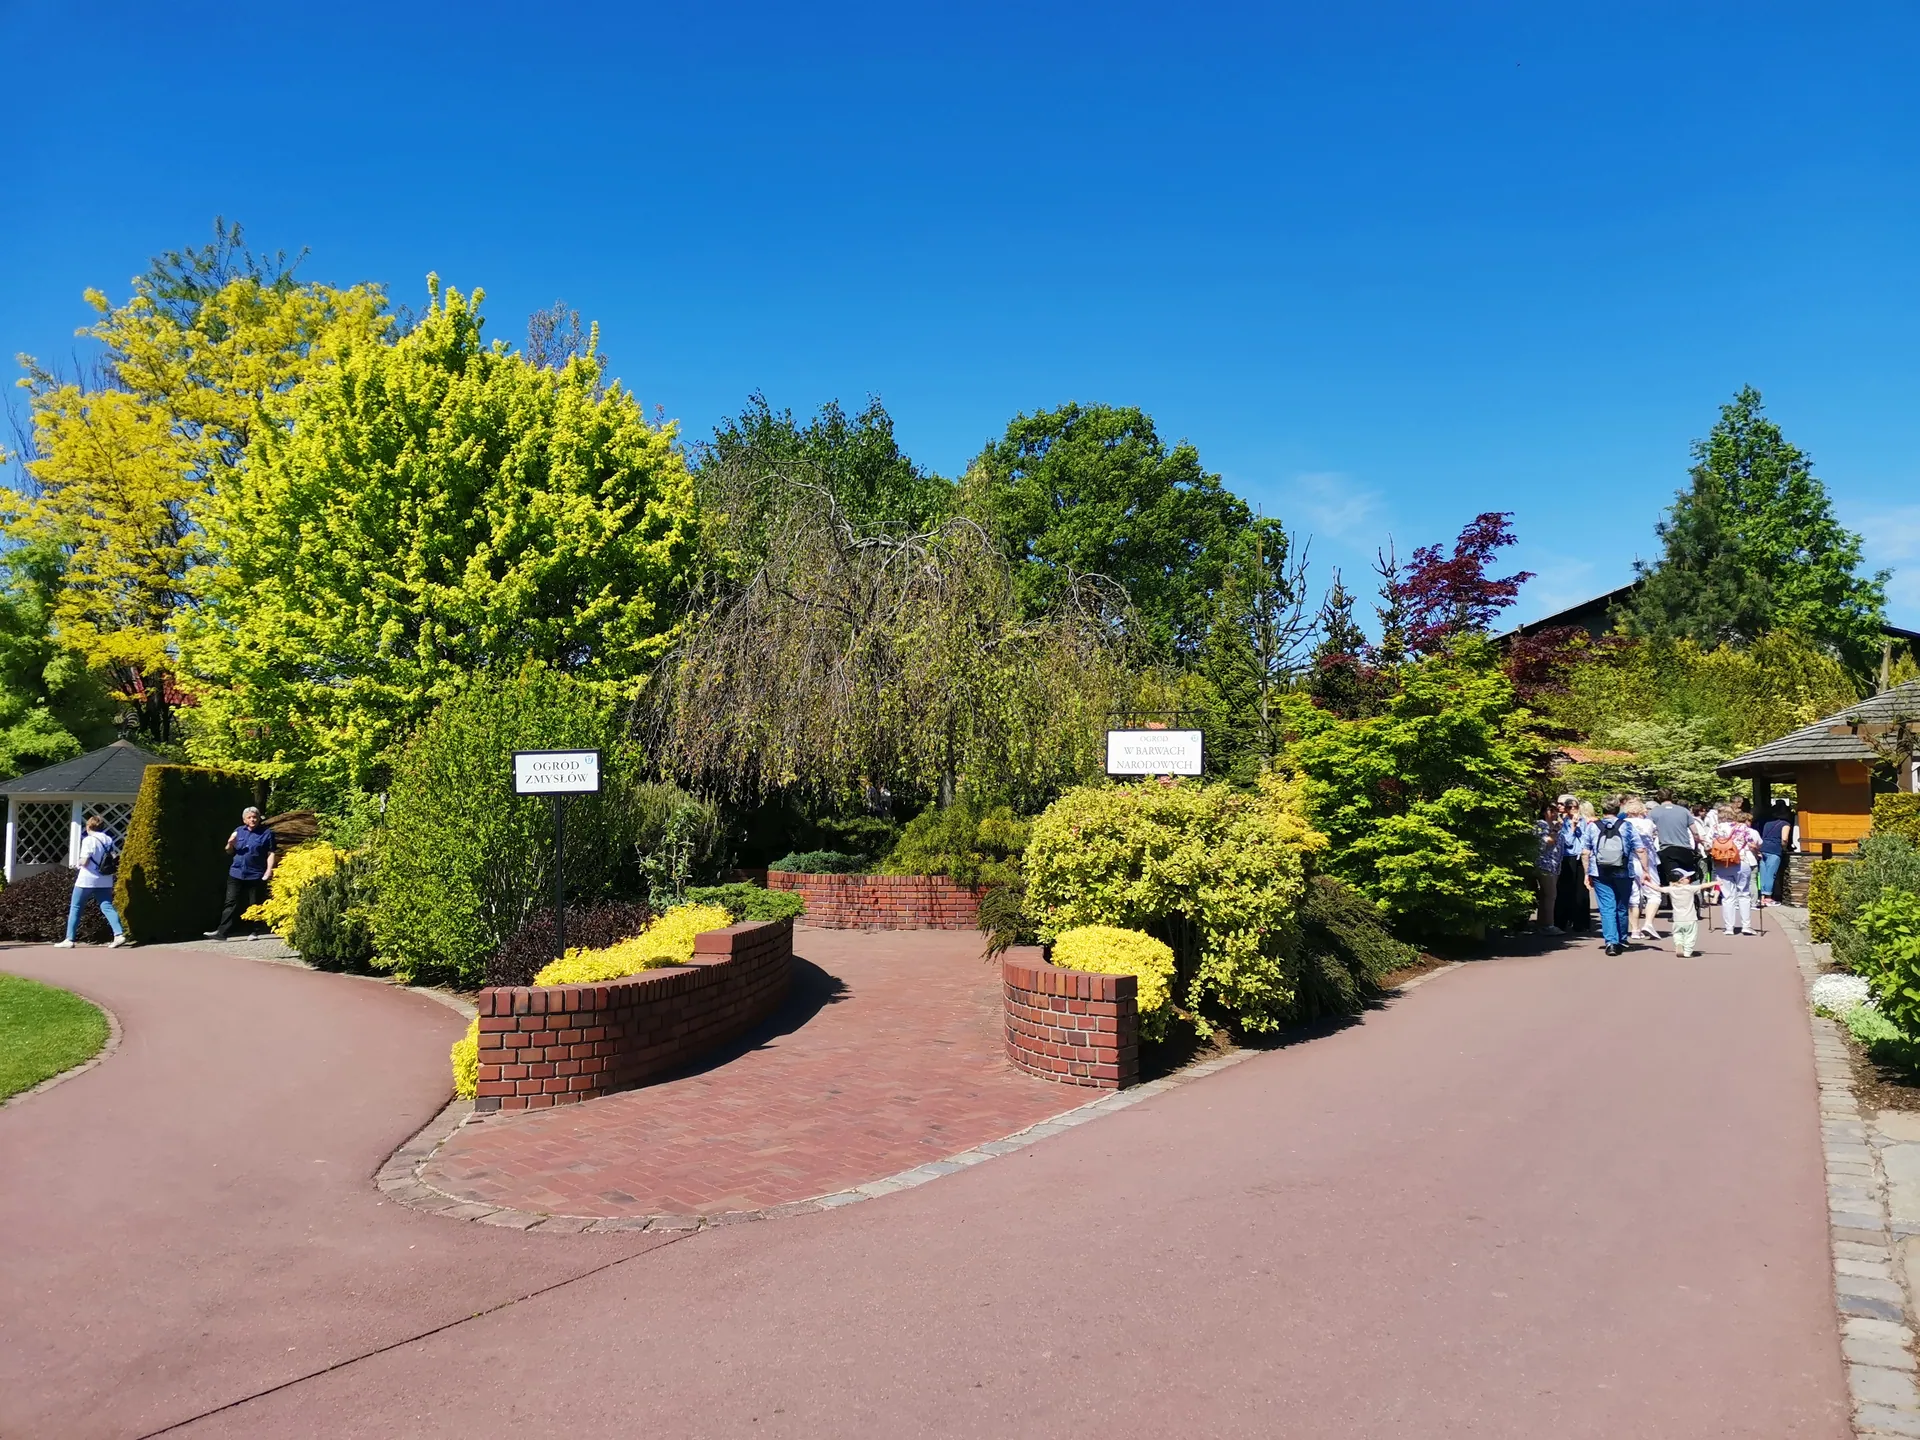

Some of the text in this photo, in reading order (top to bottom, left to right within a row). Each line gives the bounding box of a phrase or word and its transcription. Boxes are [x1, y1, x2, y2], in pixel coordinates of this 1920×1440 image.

[1123, 746, 1185, 755] W BARWACH
[533, 759, 580, 771] OGRÓD
[1116, 760, 1193, 770] NARODOWYCH
[525, 772, 589, 784] ZMYSŁÓW
